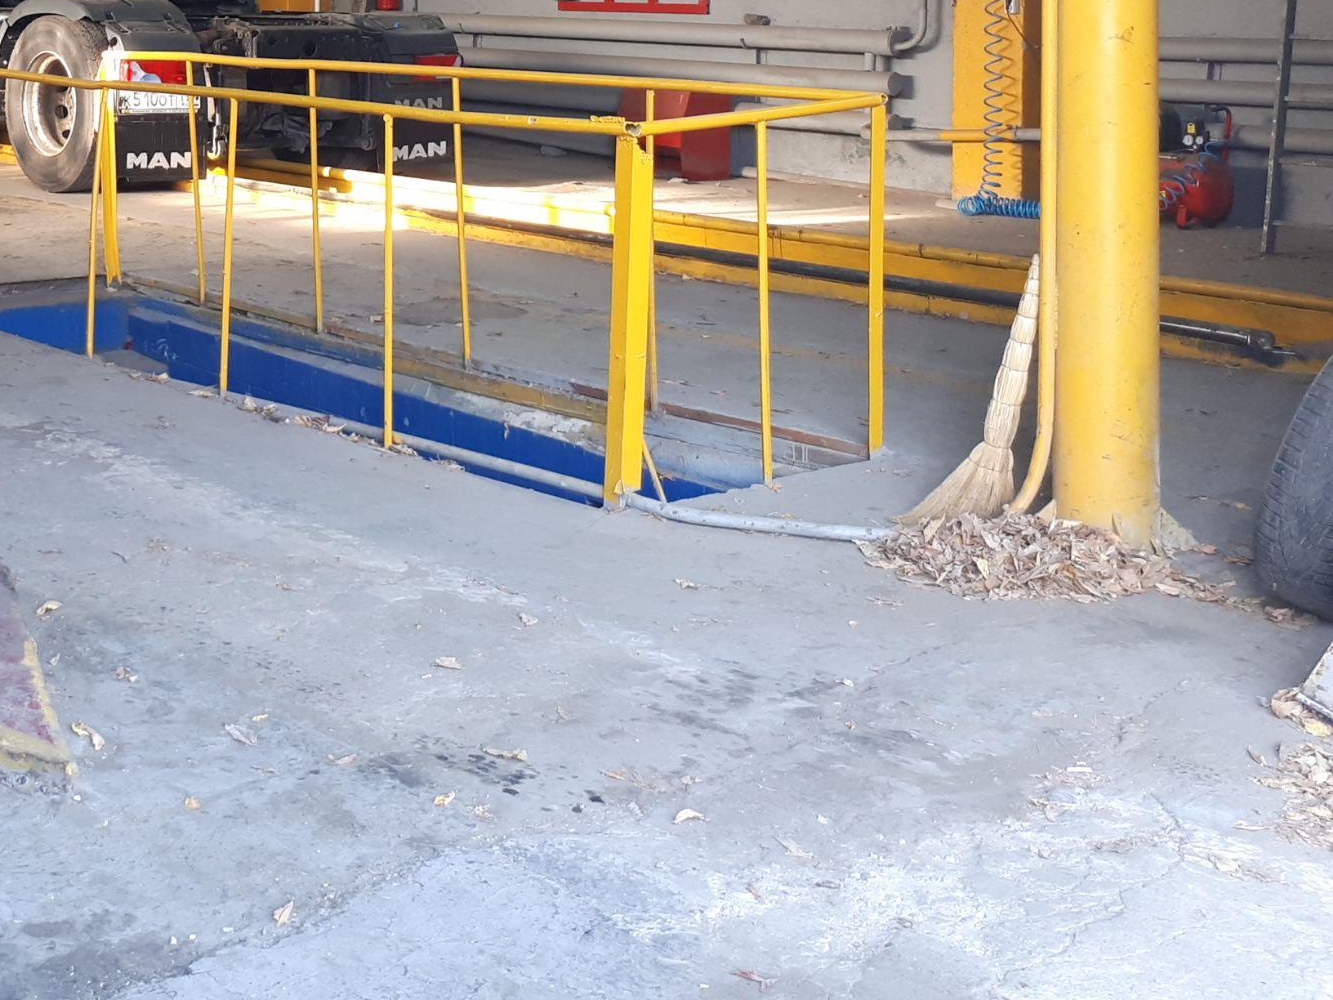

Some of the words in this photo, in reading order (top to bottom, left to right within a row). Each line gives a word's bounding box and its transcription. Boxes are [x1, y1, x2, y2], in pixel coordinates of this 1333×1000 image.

[394, 96, 443, 109] MAN
[126, 151, 192, 170] MAN
[392, 140, 447, 162] MAN
